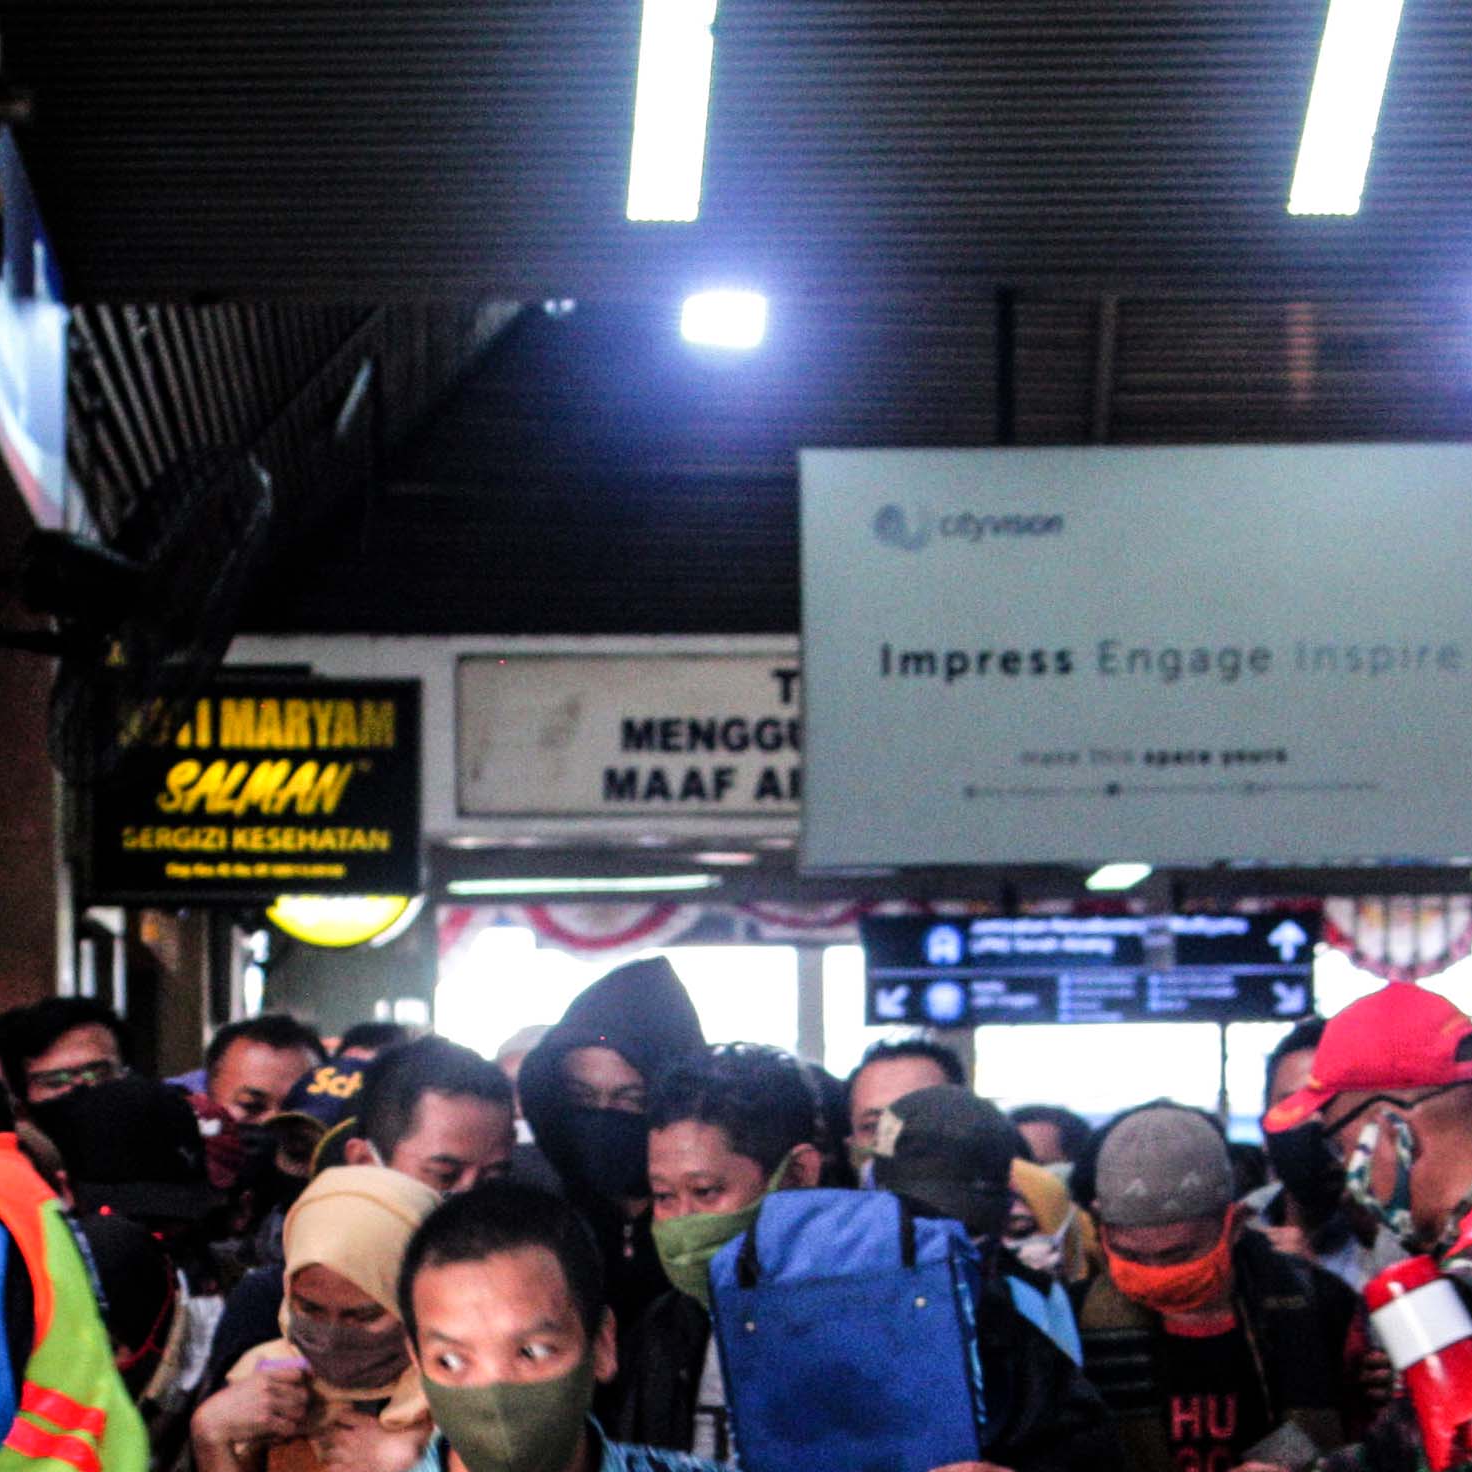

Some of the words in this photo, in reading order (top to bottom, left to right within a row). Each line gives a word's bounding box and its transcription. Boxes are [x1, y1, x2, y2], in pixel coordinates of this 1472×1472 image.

[881, 642, 1074, 685] Impress
[1097, 638, 1274, 683] Engage
[1293, 641, 1463, 676] Inspire
[219, 697, 395, 749] MARYAM
[156, 757, 354, 816] SALMAN
[602, 766, 737, 801] MAAF
[231, 825, 392, 851] KESEHATAN
